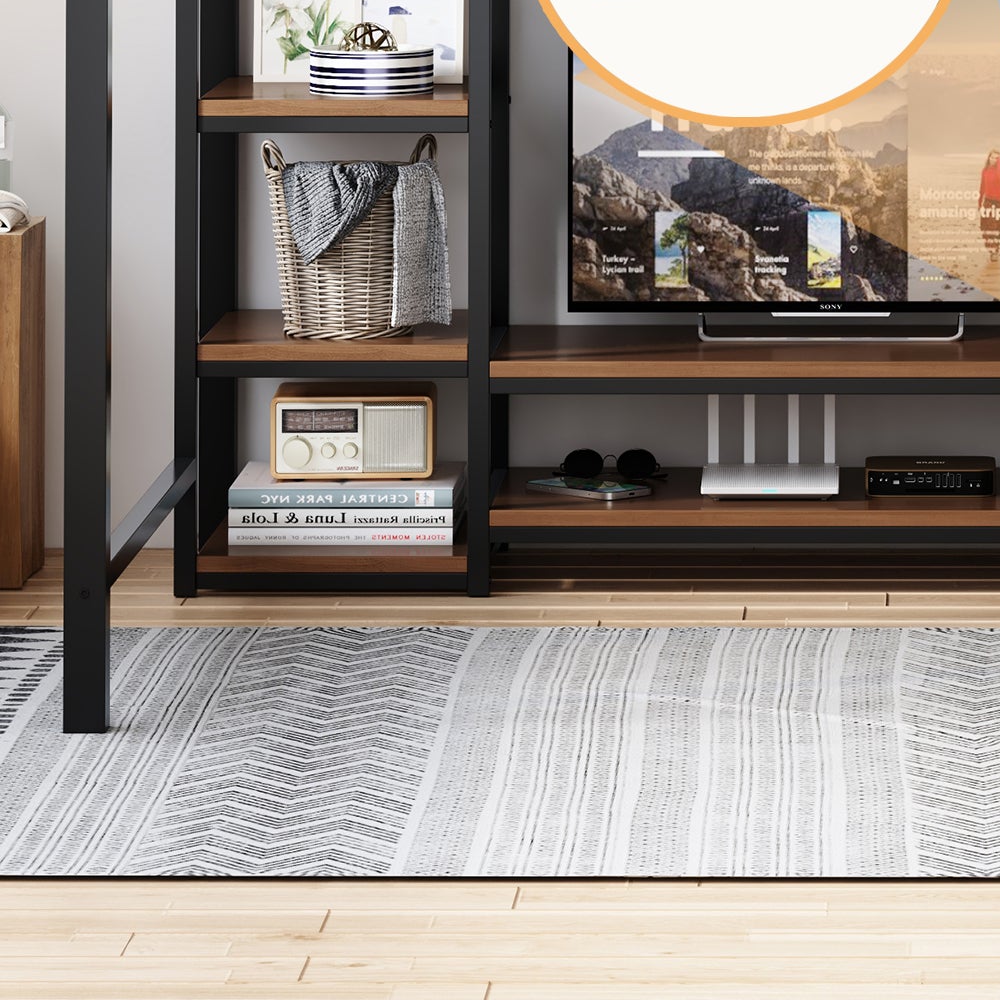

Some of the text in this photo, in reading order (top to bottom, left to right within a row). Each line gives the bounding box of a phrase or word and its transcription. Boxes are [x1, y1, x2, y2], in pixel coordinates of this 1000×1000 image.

[920, 188, 980, 200] Morocco
[919, 205, 977, 221] amazing
[602, 255, 629, 265] Turkey
[754, 255, 789, 263] Svanetia
[602, 266, 627, 275] Lycian
